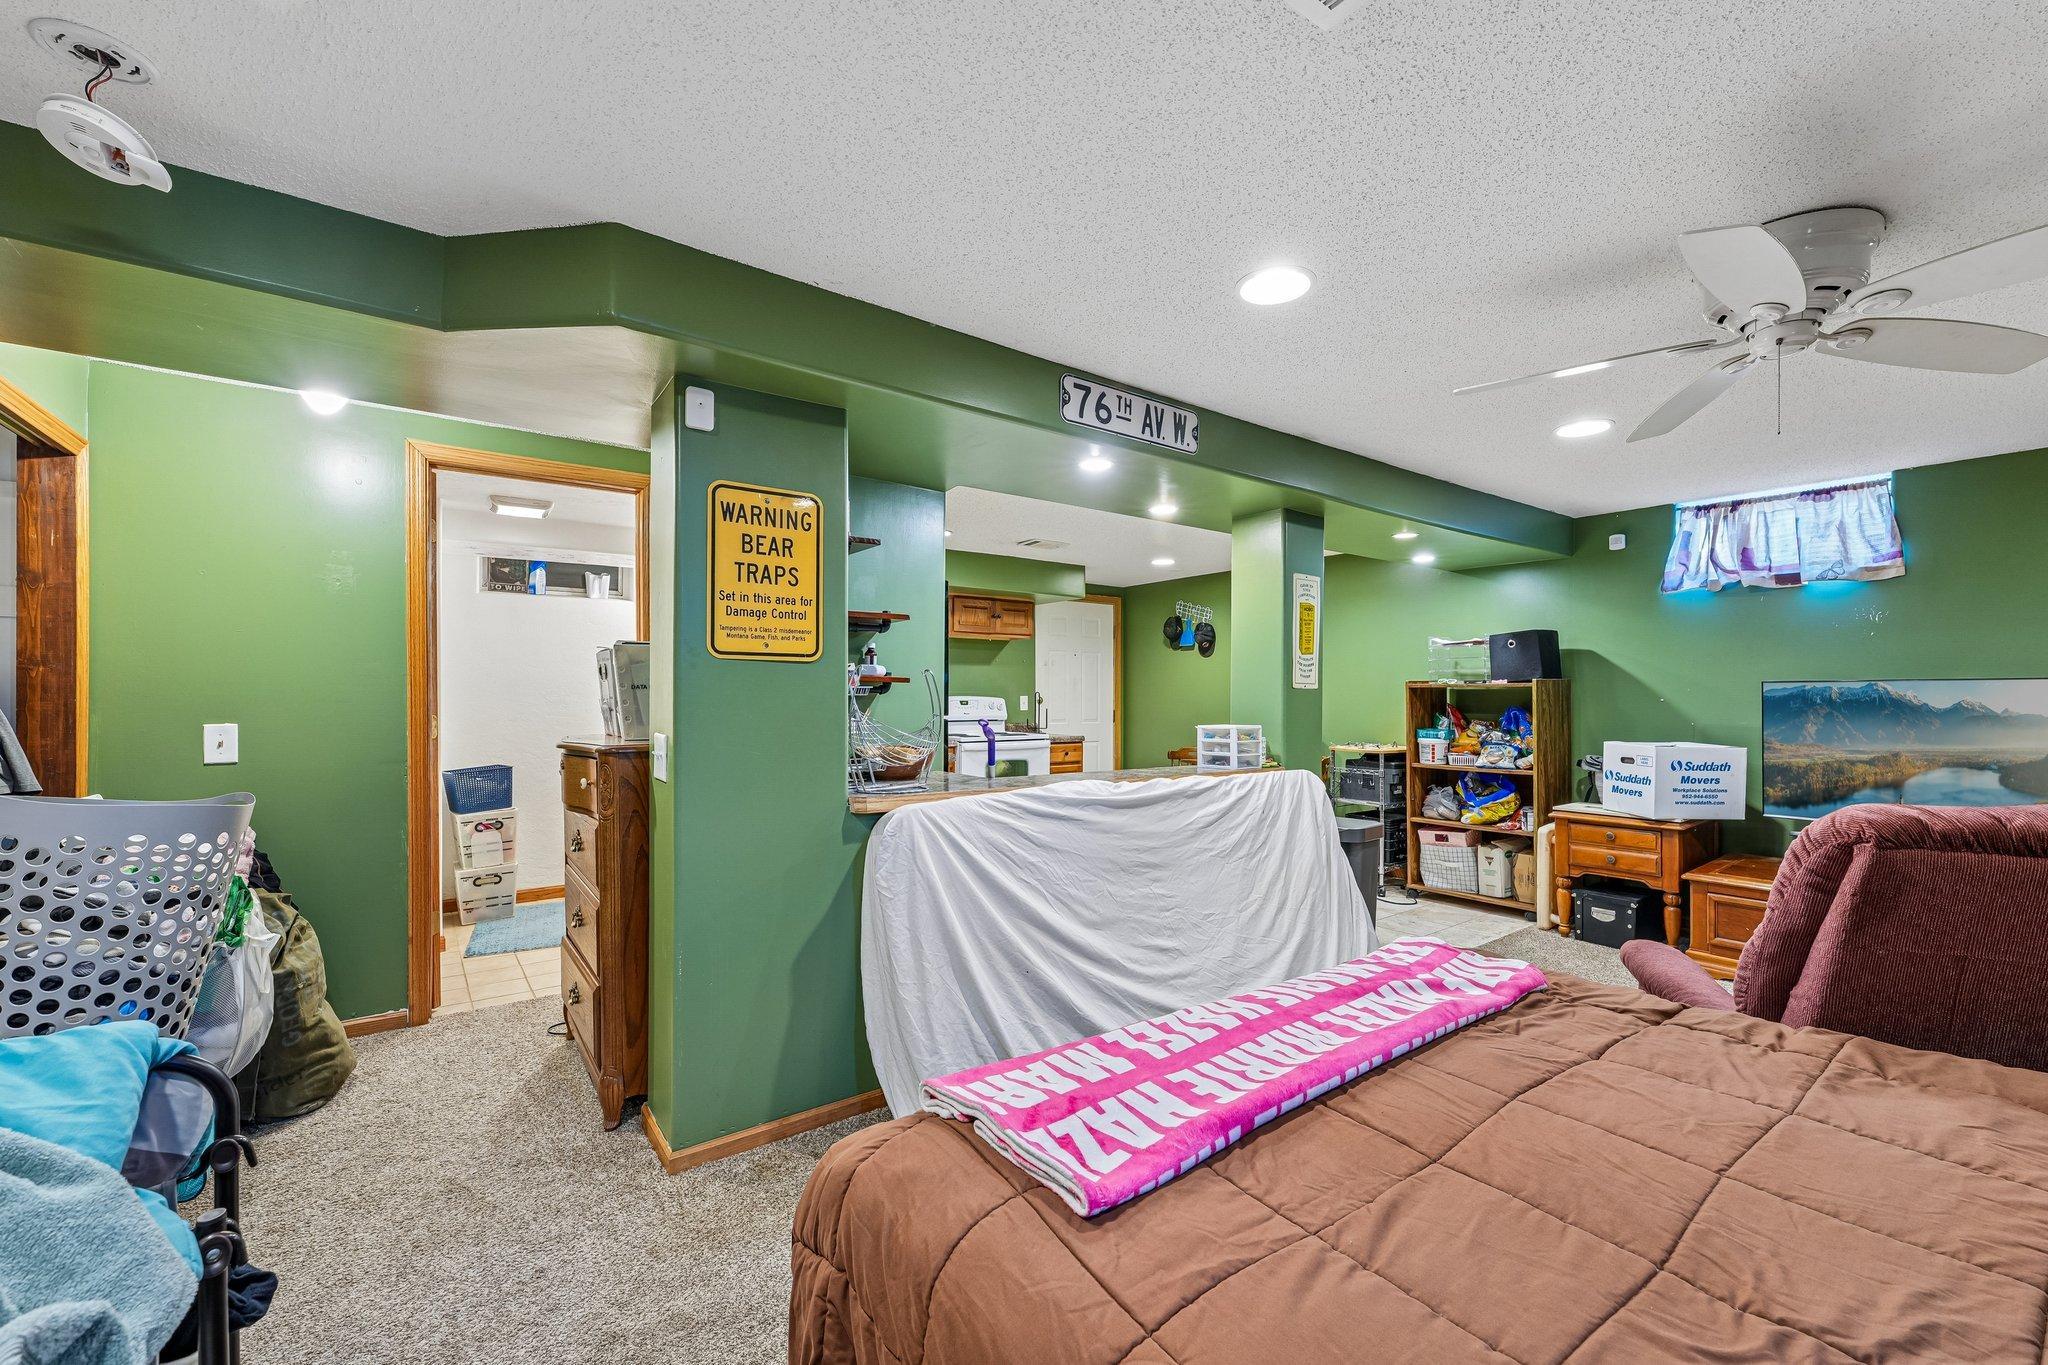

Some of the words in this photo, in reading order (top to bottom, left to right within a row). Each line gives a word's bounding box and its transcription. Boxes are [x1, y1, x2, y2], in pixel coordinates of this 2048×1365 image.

[1141, 403, 1166, 440] AV.
[1173, 411, 1190, 447] W.
[720, 501, 812, 532] WARNING
[741, 533, 794, 559] BEAR
[734, 562, 799, 587] TRAPS
[719, 590, 736, 602] Set
[740, 592, 749, 602] in
[753, 593, 772, 604] this
[775, 596, 796, 606] area
[800, 596, 813, 607] for
[726, 605, 767, 621] Damage
[771, 608, 806, 621] Control
[719, 624, 747, 633] Tampering
[1683, 761, 1731, 772] Suddath
[1614, 772, 1652, 787] Suddath
[1681, 775, 1721, 785] Movers
[1611, 784, 1643, 798] Movers
[1099, 998, 1274, 1060] HAZEL
[1163, 1021, 1362, 1104] MARIE
